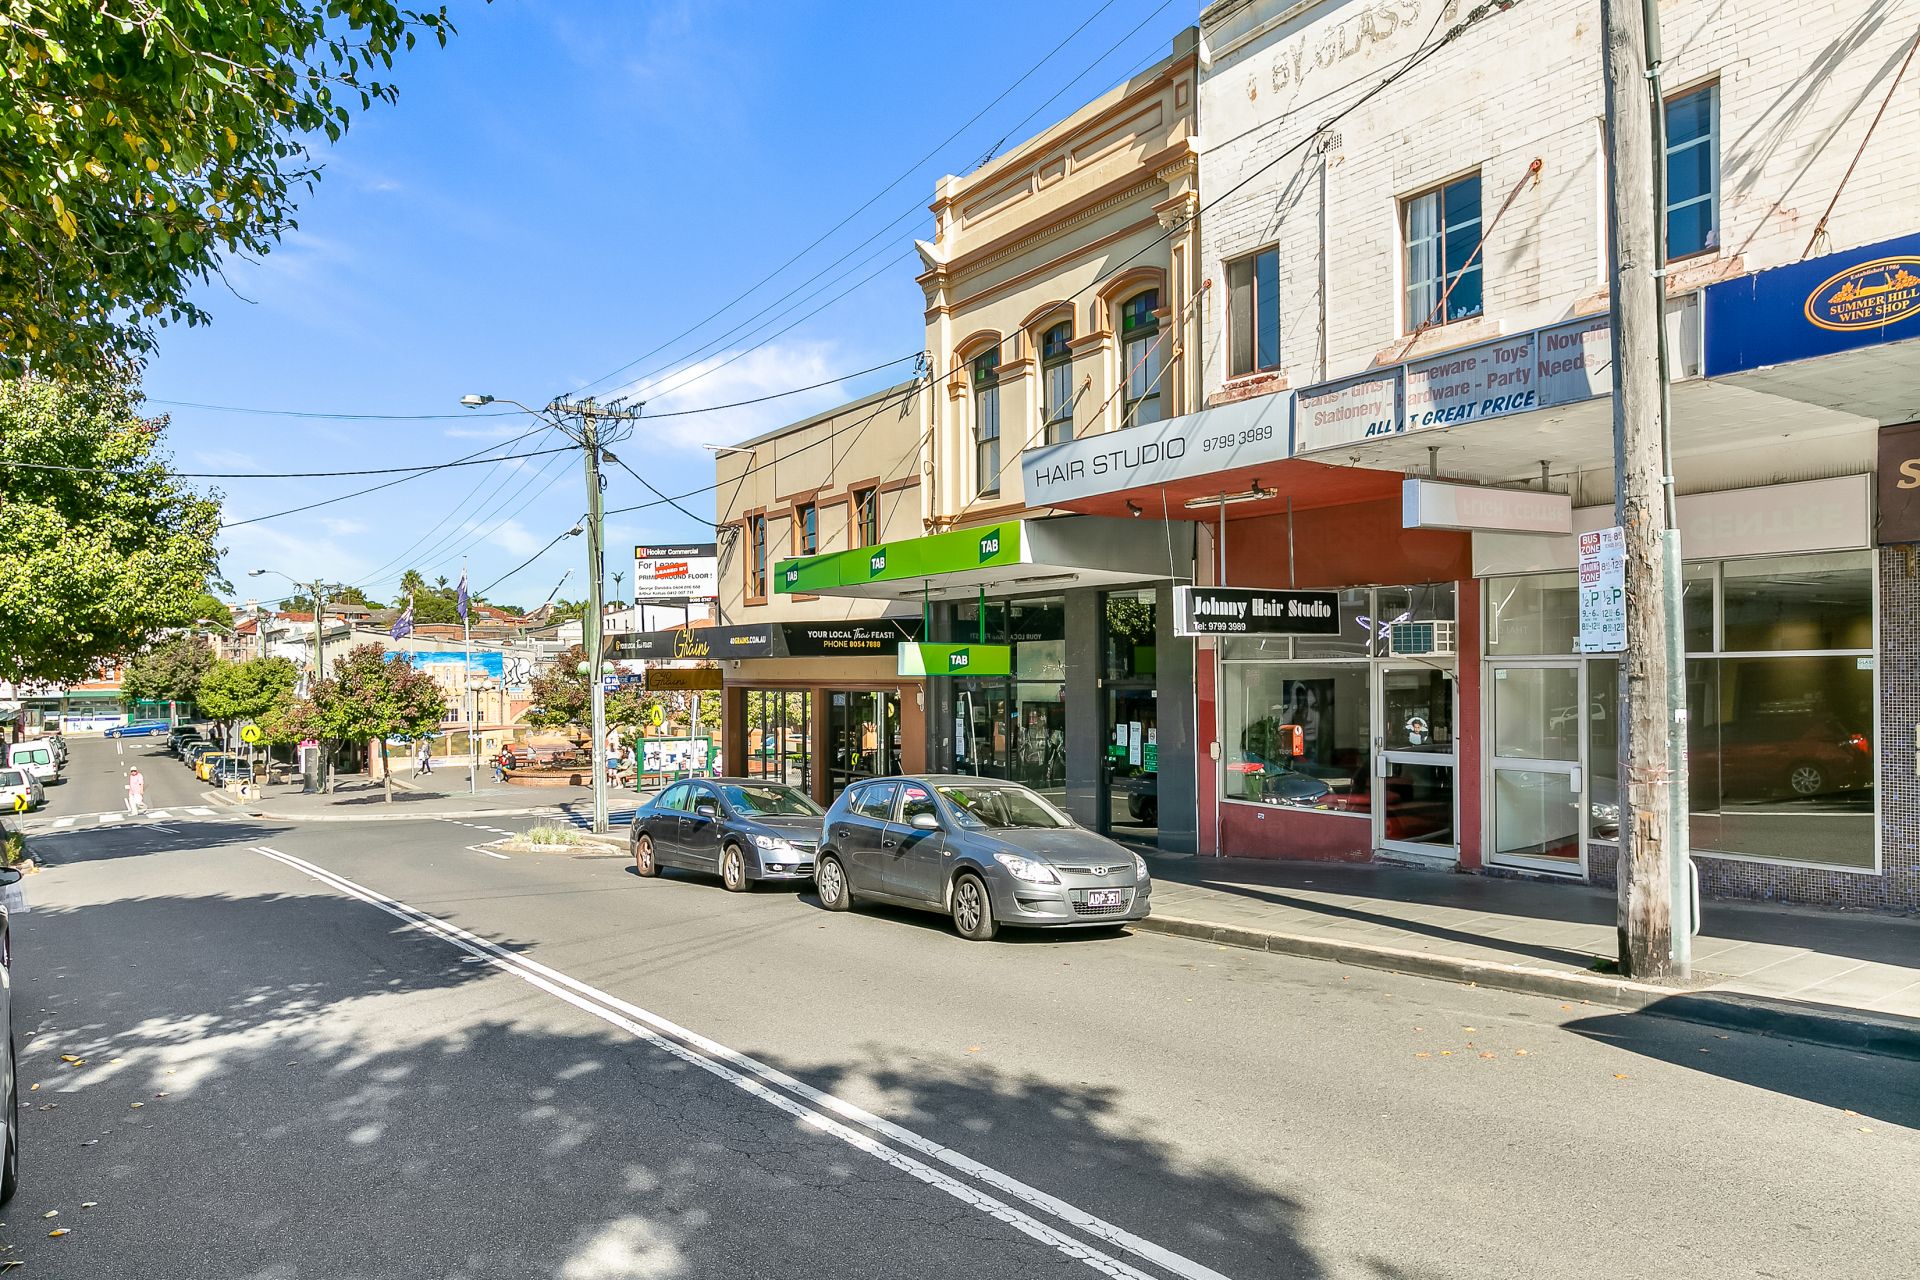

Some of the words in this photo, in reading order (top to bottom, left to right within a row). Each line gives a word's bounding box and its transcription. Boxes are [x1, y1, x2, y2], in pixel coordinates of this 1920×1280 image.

[1830, 295, 1885, 315] SUMMER
[1888, 288, 1919, 304] HILL
[1840, 308, 1873, 322] WINE
[1875, 300, 1910, 315] SHOP
[1492, 343, 1529, 365] Toys
[1314, 401, 1382, 427] Stationery
[1487, 367, 1531, 390] Party
[1365, 418, 1392, 438] ALL
[1422, 400, 1474, 426] GREAT
[1480, 390, 1536, 416] PRICE
[1035, 459, 1085, 487] HAIR
[1092, 437, 1186, 475] STUDIO
[1203, 434, 1235, 452] 9799
[1238, 425, 1273, 445] 3989
[981, 539, 999, 553] TAB
[1582, 534, 1598, 545] BUS
[1580, 544, 1600, 555] ZONE
[638, 561, 652, 569] For
[871, 557, 886, 570] TAB
[786, 570, 798, 582] TAB
[1580, 572, 1600, 583] ZONE
[1193, 597, 1247, 619] Johnny
[1252, 598, 1284, 617] Hair
[1288, 599, 1332, 618] Studio
[1193, 622, 1207, 631] Tel:
[1208, 622, 1227, 631] 9799
[683, 628, 694, 644] 40
[807, 630, 828, 638] YOUR
[829, 630, 852, 638] LOCAL
[853, 627, 871, 640] Thai
[871, 631, 895, 639] FEAST!
[674, 629, 710, 659] Grains
[823, 640, 848, 648] PHONE
[950, 655, 968, 665] TAB
